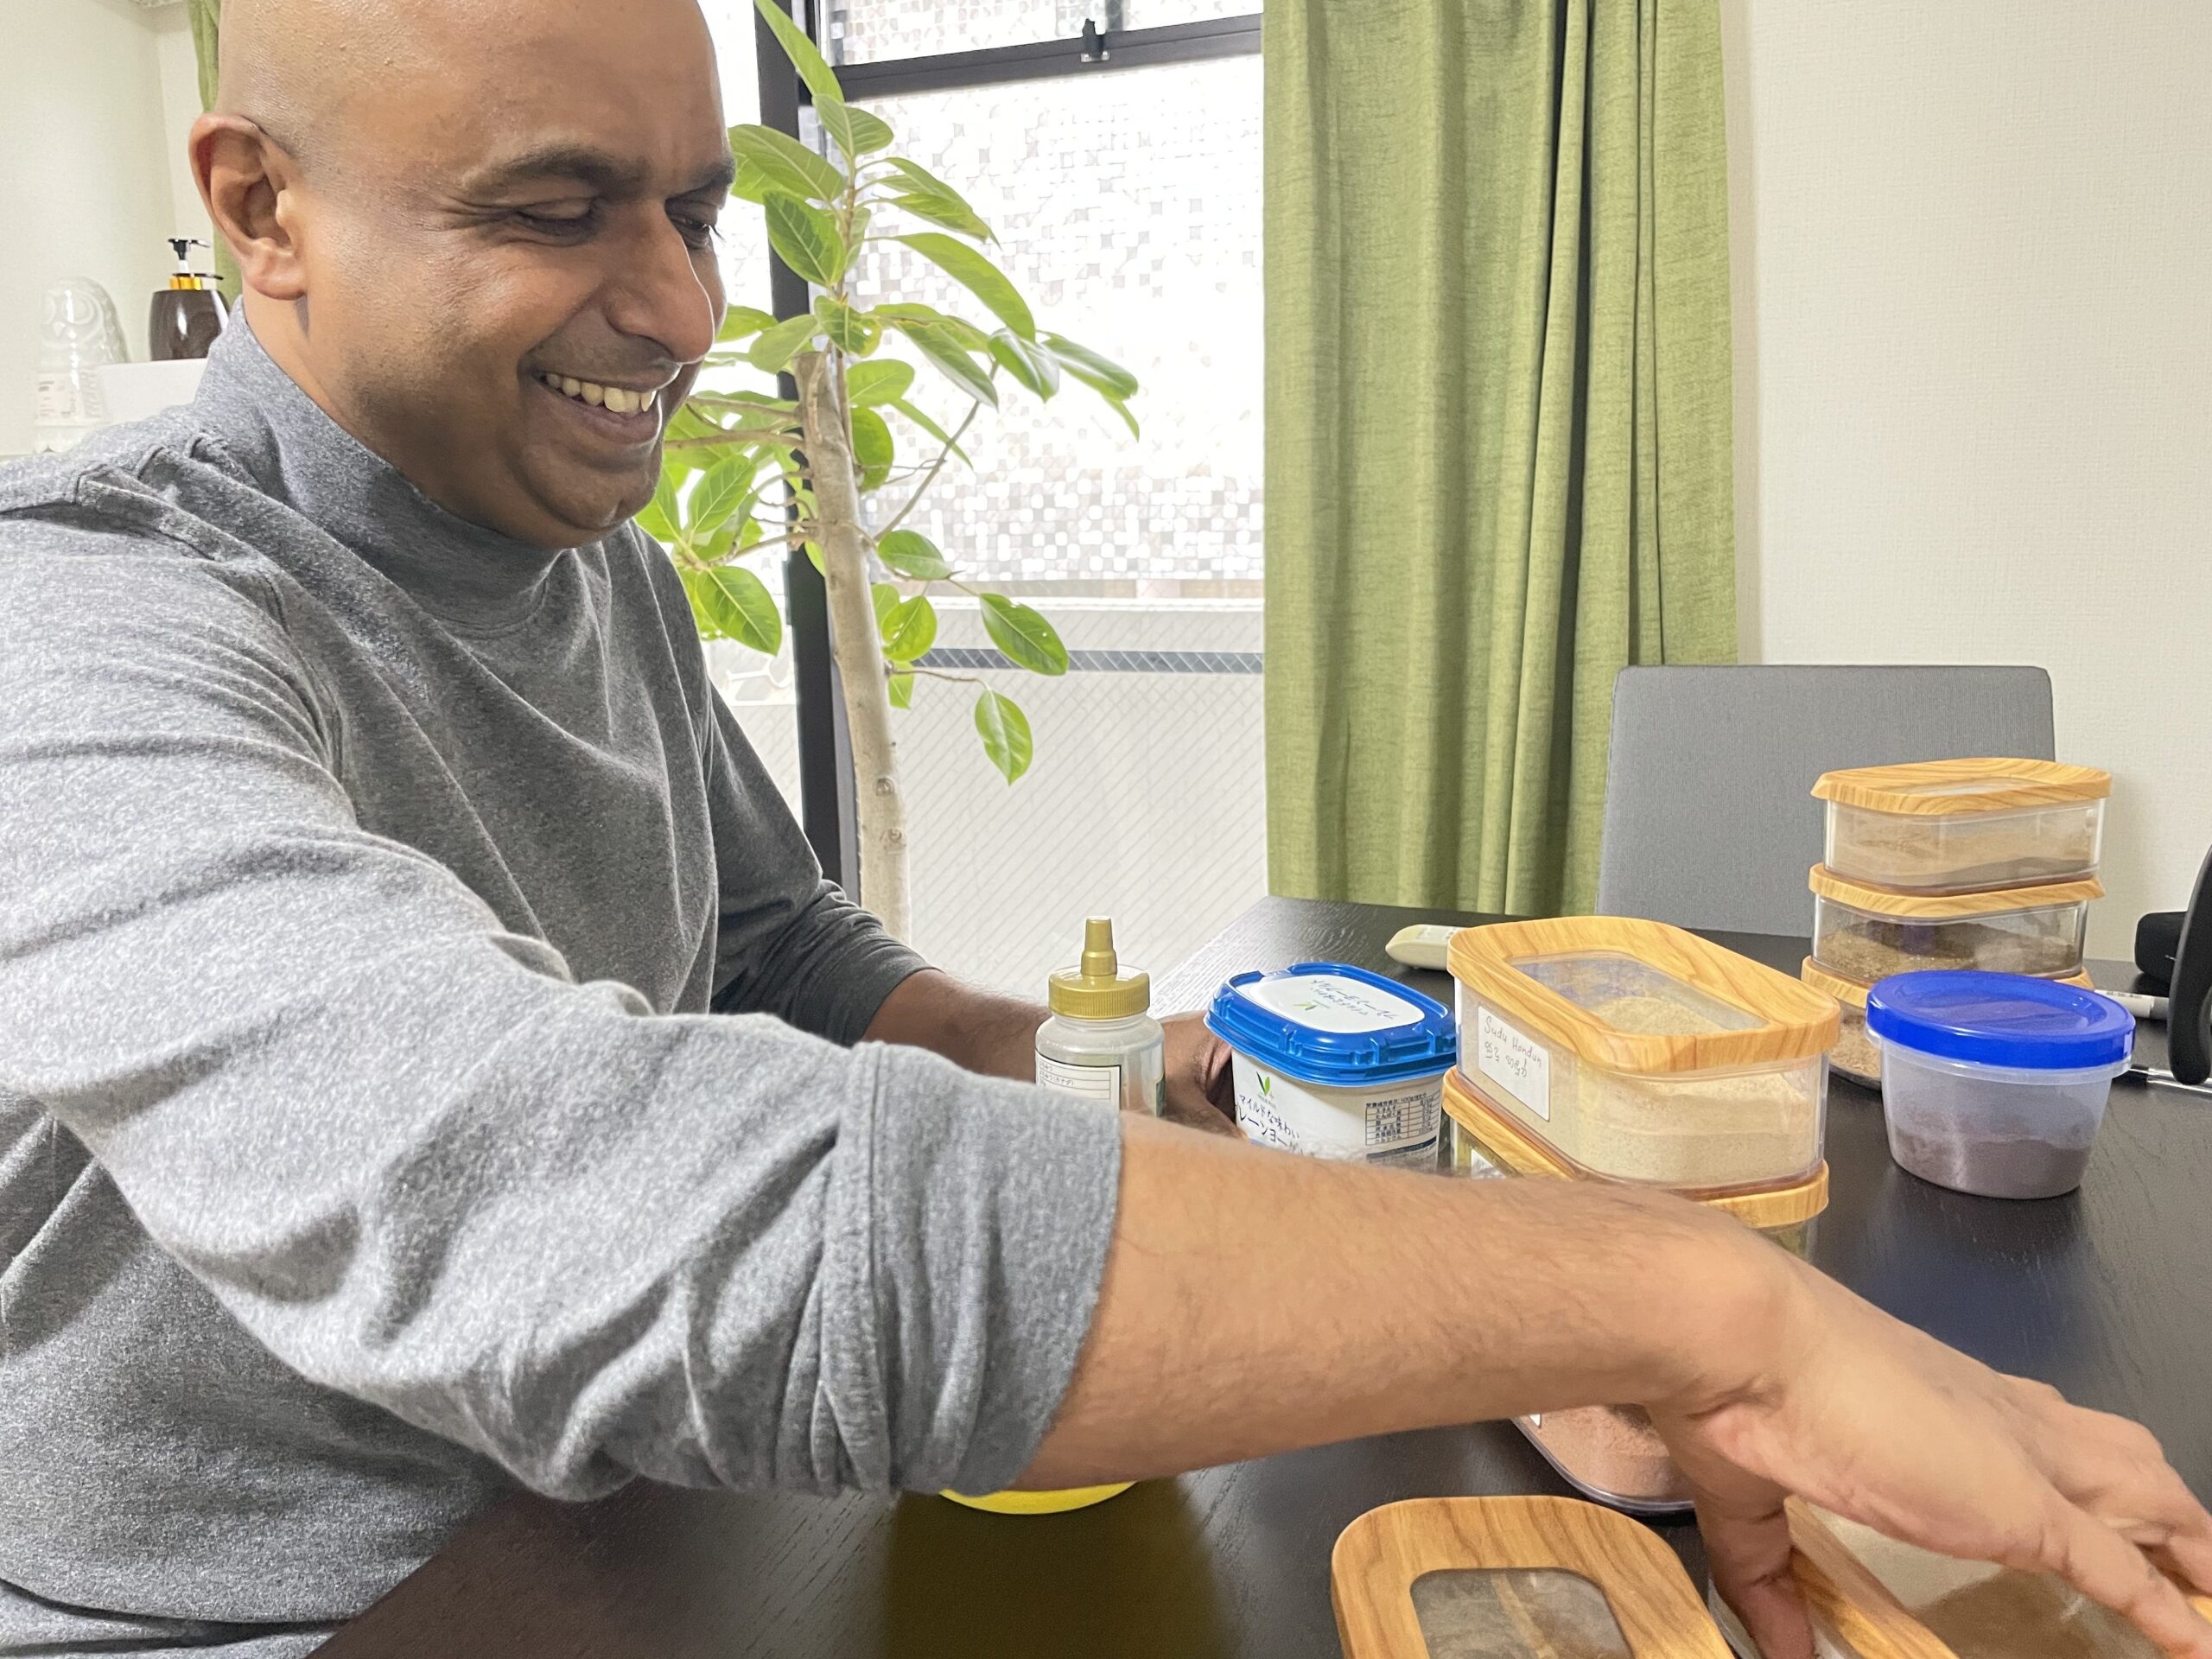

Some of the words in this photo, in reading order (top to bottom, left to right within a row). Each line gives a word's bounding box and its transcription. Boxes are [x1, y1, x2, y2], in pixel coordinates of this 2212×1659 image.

[1484, 1015, 1507, 1042] Sudu
[1239, 1094, 1300, 1139] マイルドな味わい
